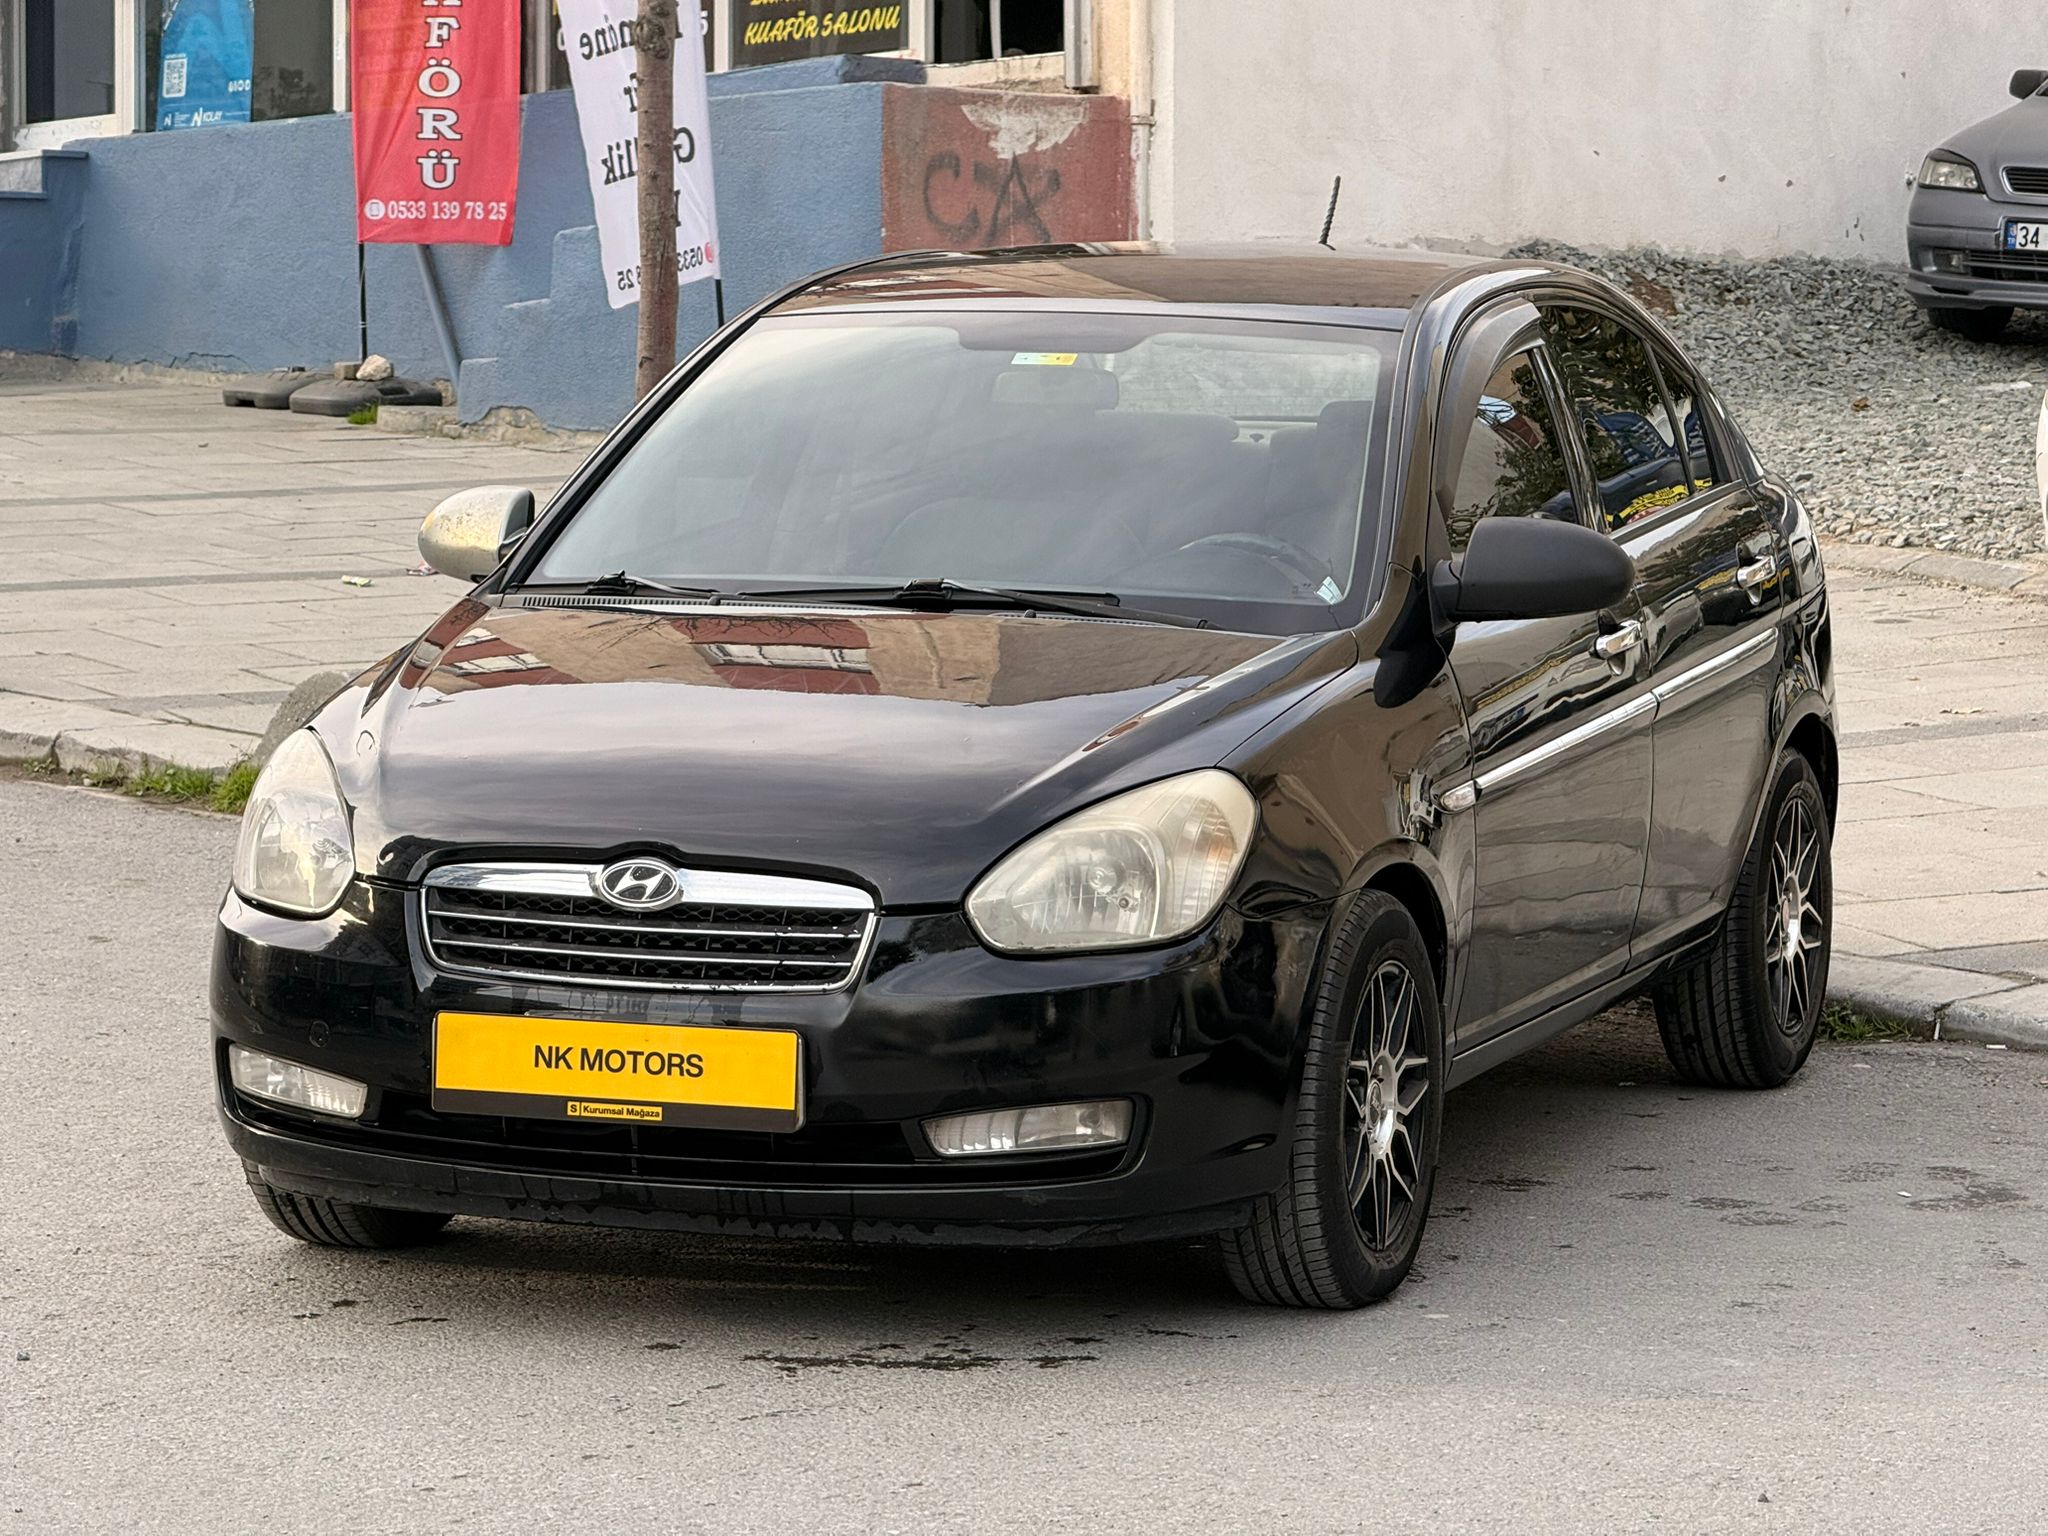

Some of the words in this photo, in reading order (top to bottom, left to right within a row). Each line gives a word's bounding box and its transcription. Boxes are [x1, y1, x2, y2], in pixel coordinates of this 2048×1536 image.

[744, 10, 819, 45] KUAFÖR
[820, 5, 900, 37] SALONU
[416, 0, 463, 190] FÖRÜ
[387, 201, 426, 219] 0533
[432, 201, 460, 219] 139
[465, 202, 484, 219] 78
[488, 202, 507, 220] 25
[2018, 226, 2040, 248] 34
[533, 1045, 573, 1071] NK
[580, 1047, 704, 1078] MOTORS
[570, 1104, 577, 1113] S
[583, 1105, 624, 1115] Kurumsal
[626, 1108, 660, 1118] Mağaza
